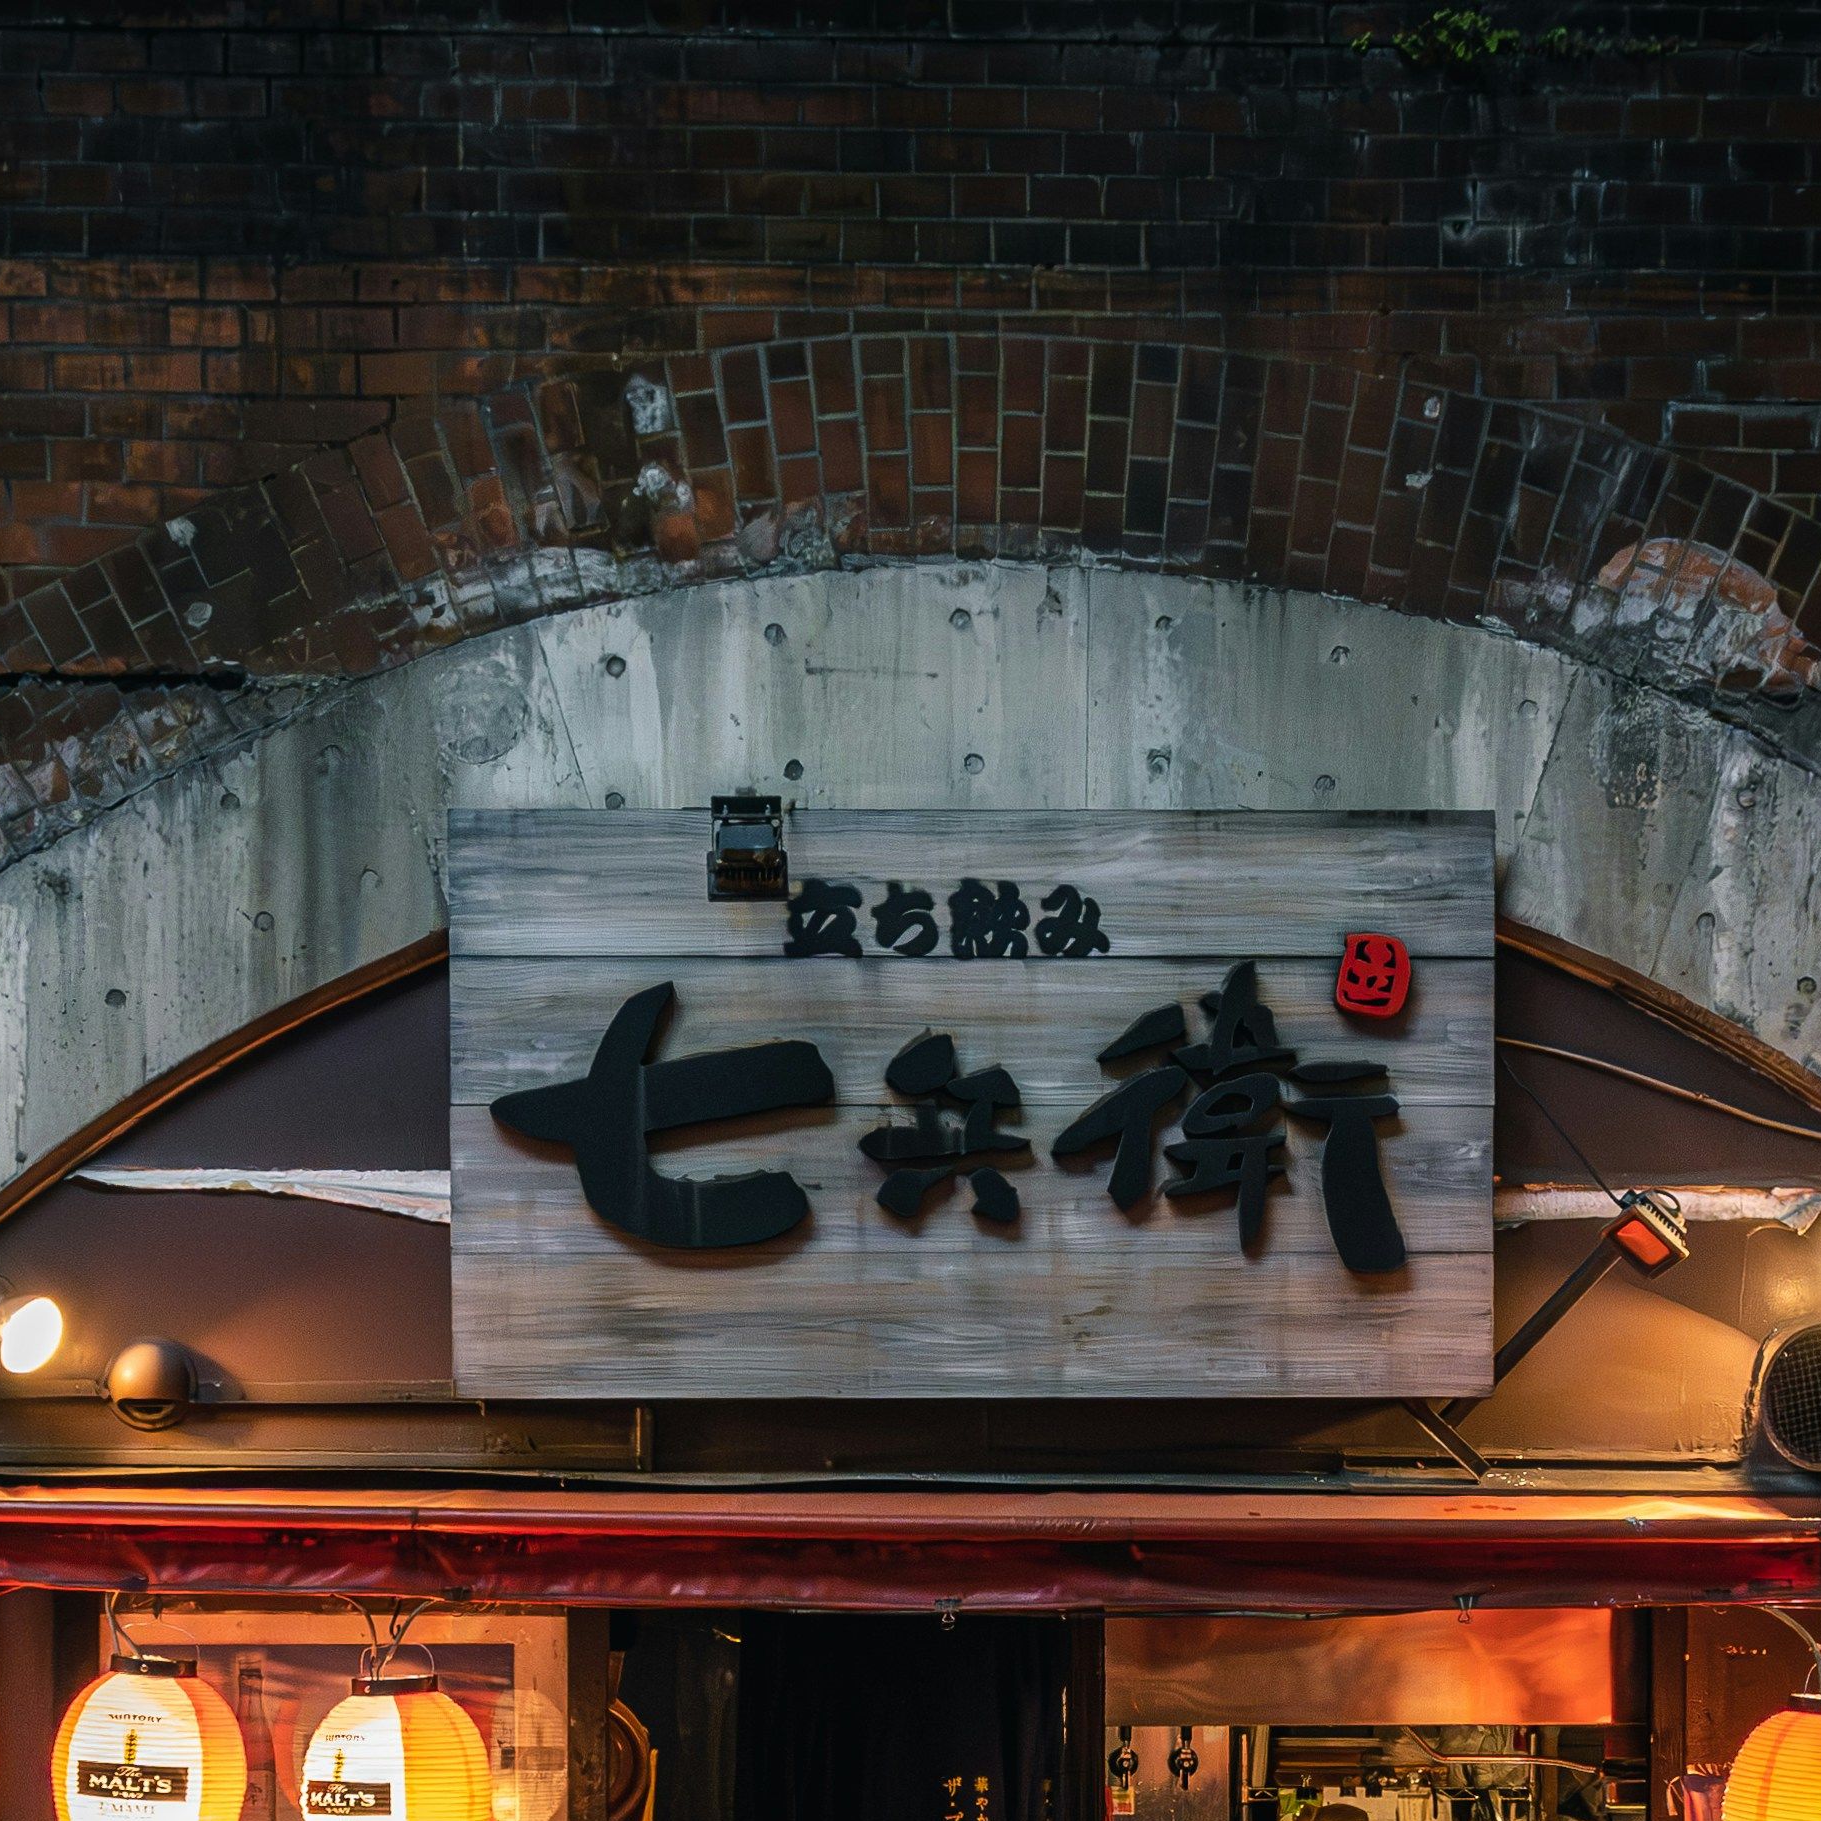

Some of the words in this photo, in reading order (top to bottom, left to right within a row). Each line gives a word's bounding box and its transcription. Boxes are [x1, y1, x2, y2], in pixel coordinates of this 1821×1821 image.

[489, 959, 1408, 1274] 七兵衛
[114, 1766, 143, 1777] The
[88, 1773, 173, 1794] MALT'S
